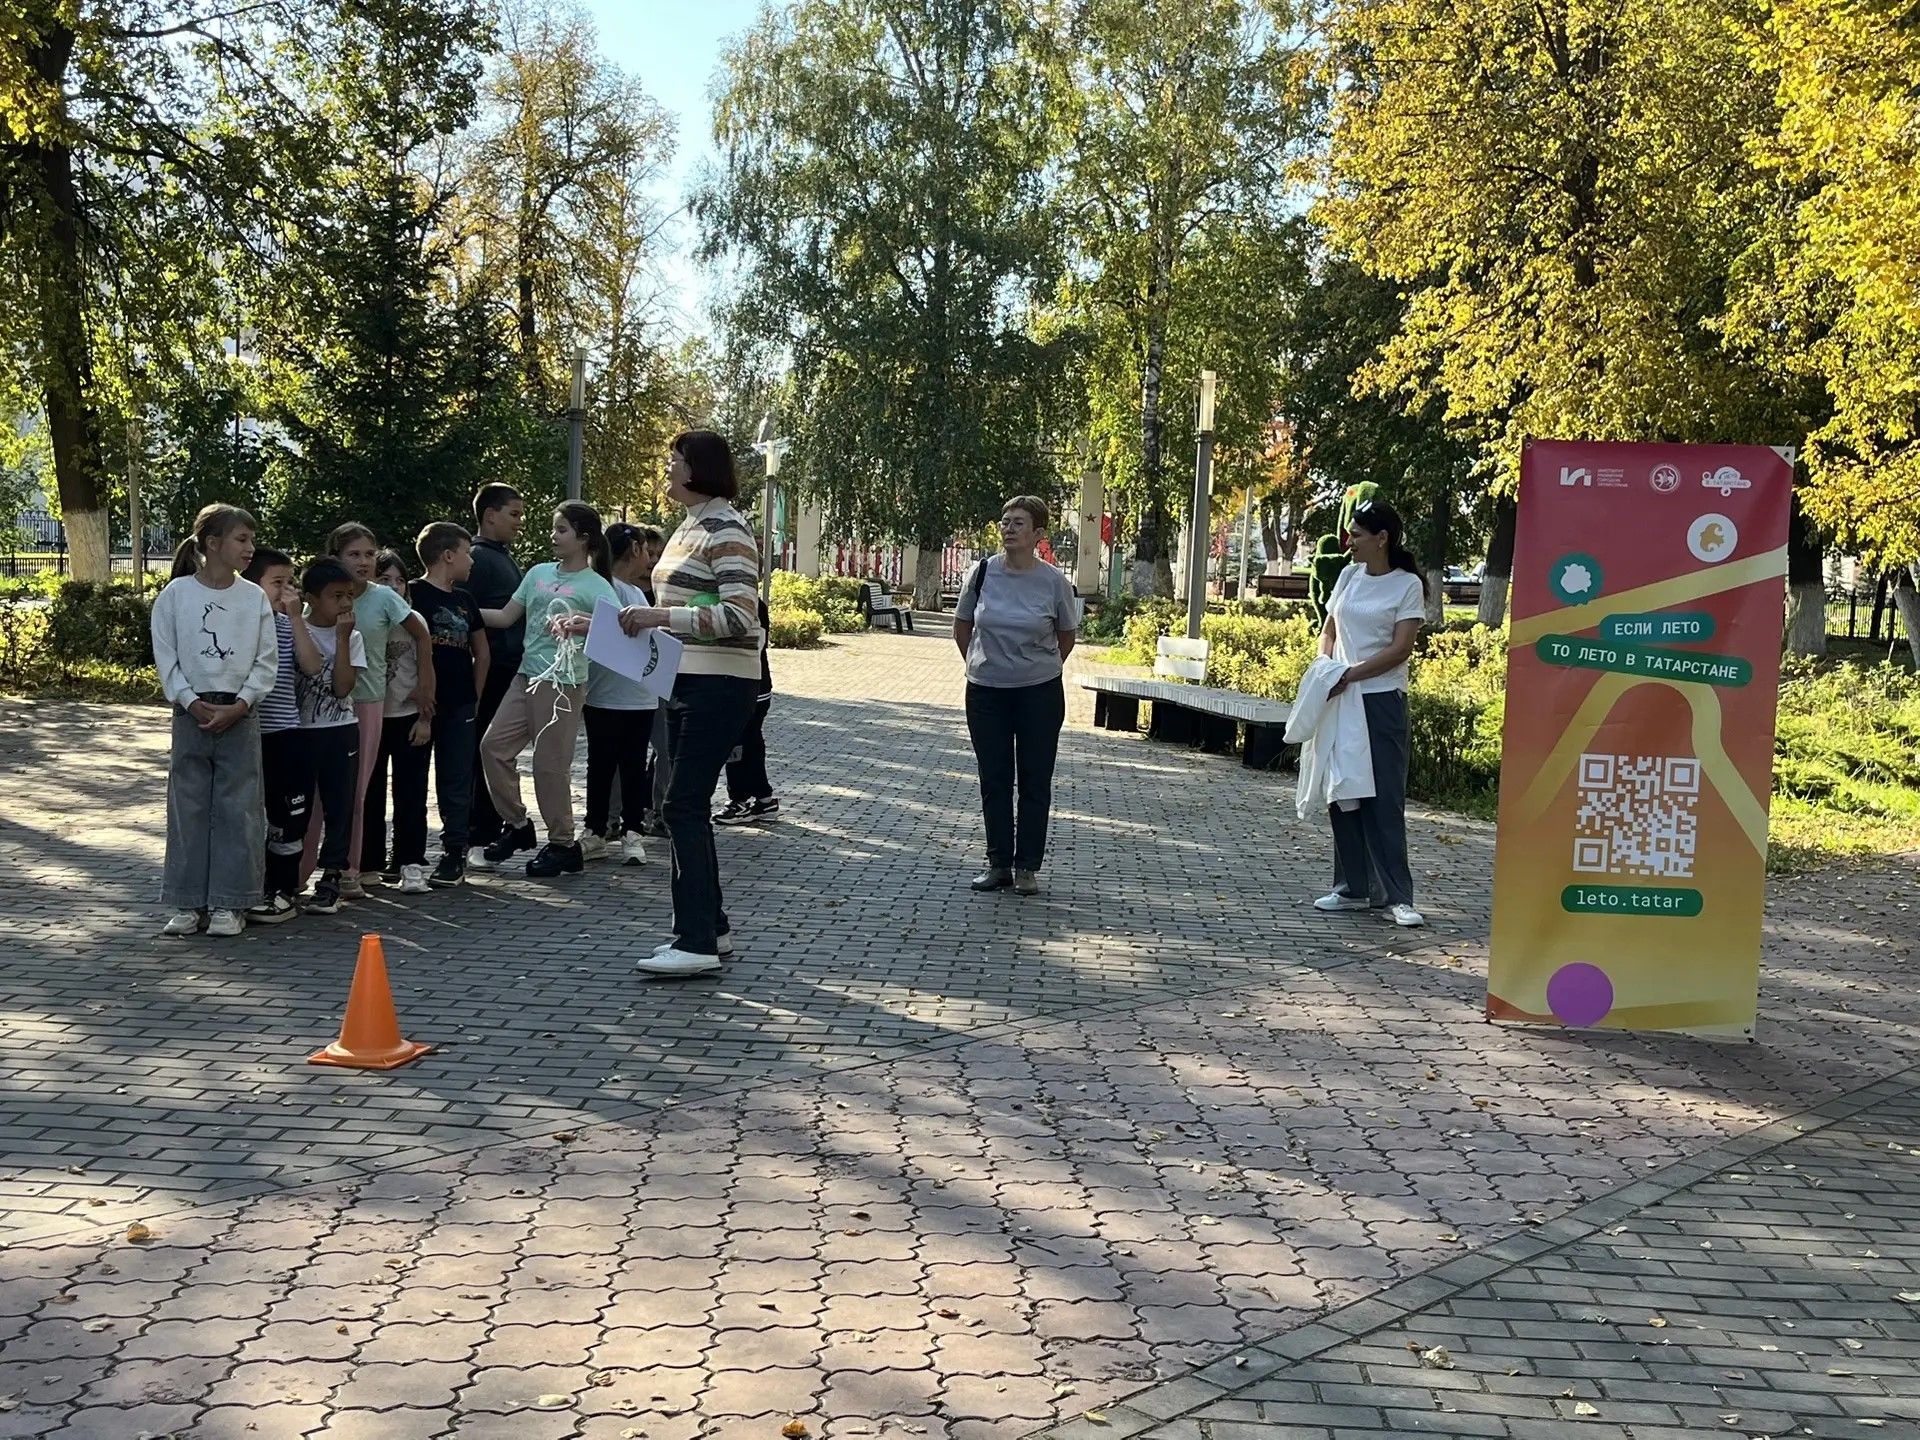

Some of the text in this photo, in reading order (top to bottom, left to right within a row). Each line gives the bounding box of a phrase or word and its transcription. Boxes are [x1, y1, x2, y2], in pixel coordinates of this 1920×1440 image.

[1614, 620, 1701, 636] ЕСЛИ ЛЕТО
[1551, 643, 1740, 680] ТО ЛЕТО В ТАТАРСТАНЕ
[1576, 889, 1684, 908] leto.tatar
